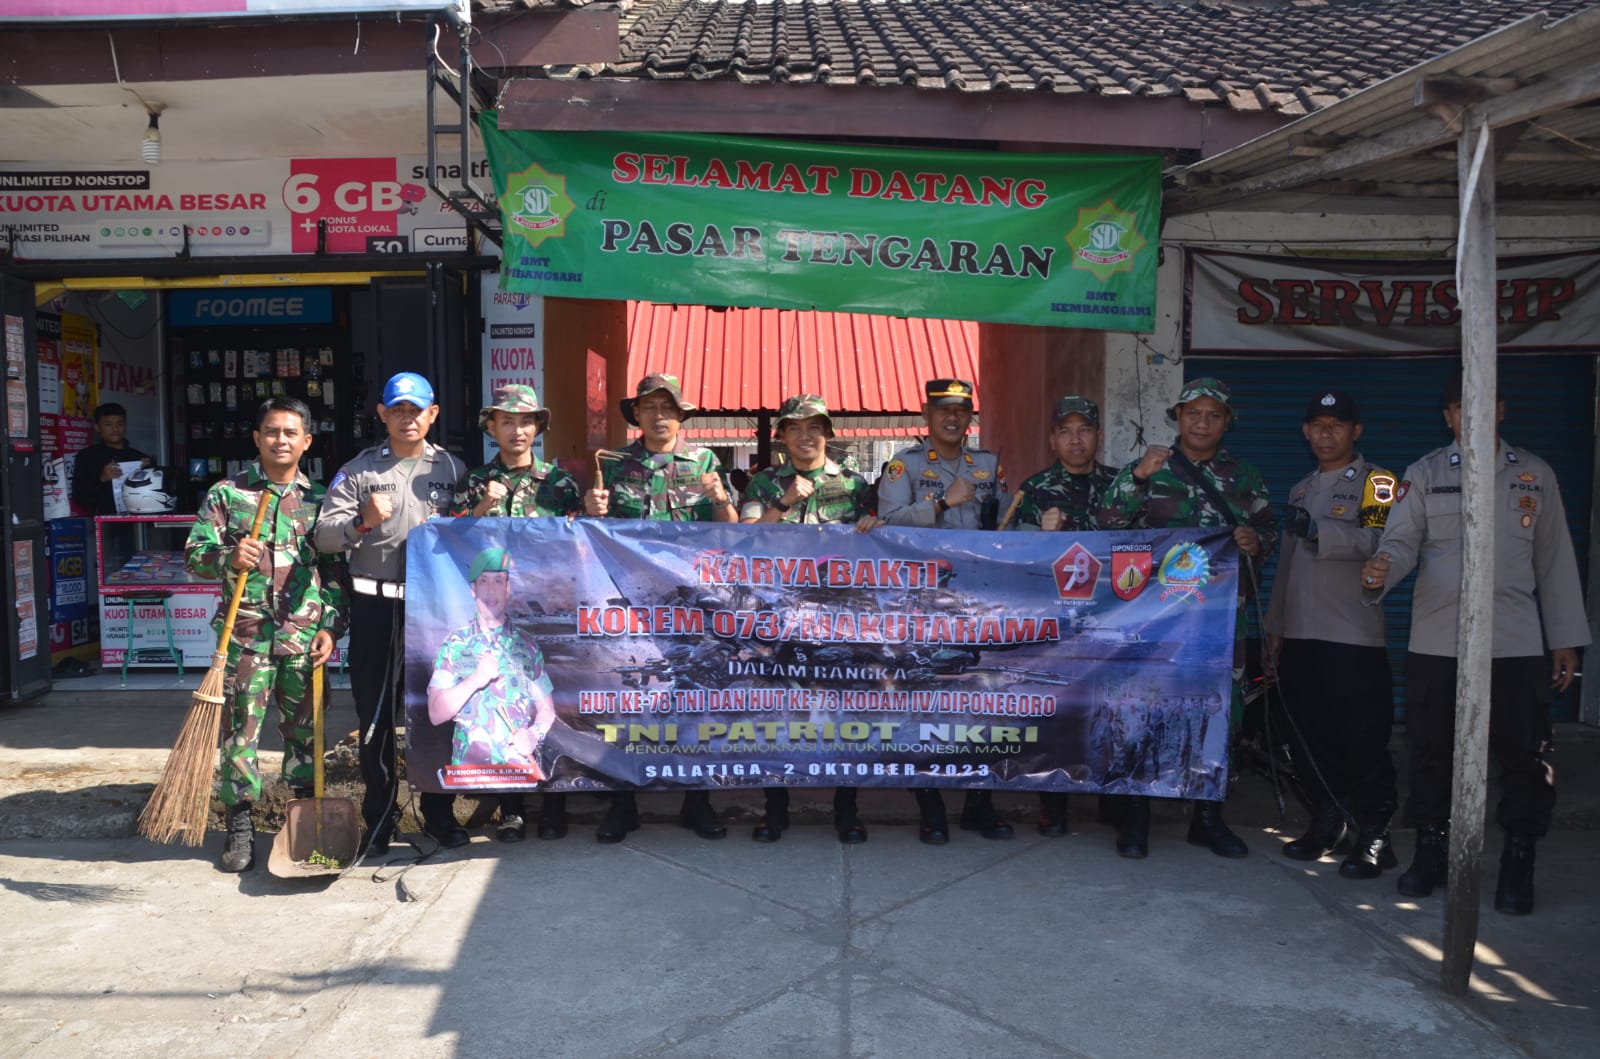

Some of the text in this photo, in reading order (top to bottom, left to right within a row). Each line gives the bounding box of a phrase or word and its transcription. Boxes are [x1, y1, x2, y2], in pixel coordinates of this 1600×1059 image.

[75, 174, 146, 186] NONSTOP
[612, 152, 1048, 209] SELAMAT DATANG
[82, 194, 174, 211] UTAMA
[180, 193, 266, 210] BESAR
[283, 173, 403, 213] 6 GB
[586, 188, 607, 212] di
[358, 224, 392, 233] LOKAL
[44, 234, 90, 243] PILIHAN
[600, 219, 1054, 280] PASAR TENGARAN
[520, 256, 550, 268] BMT
[1086, 290, 1118, 301] BMT
[1237, 277, 1576, 326] SERVIS HP
[195, 297, 304, 318] FOOMEE
[1051, 303, 1152, 316] KEMBANGSARI
[491, 347, 535, 371] KUOTA
[1112, 544, 1152, 552] DIPONEGORO
[700, 555, 938, 589] KARYA BAKTI
[175, 608, 207, 619] BESAR
[577, 606, 1060, 645] KOREM 073/MAKUTARAMA
[729, 661, 907, 680] DALAM RANGKA
[580, 688, 1056, 717] HUT KE-78 TNI DAN HUT KE-73 KODAM IV/DIPONEGORO
[596, 721, 1039, 743] TNI PATRIOT NKRI
[625, 742, 1021, 755] PENGAWAL DEMOKRASI UNTUK INDONESIA MAJU
[784, 763, 795, 776] 2
[808, 763, 915, 776] OKTOBER
[930, 763, 989, 777] 2023
